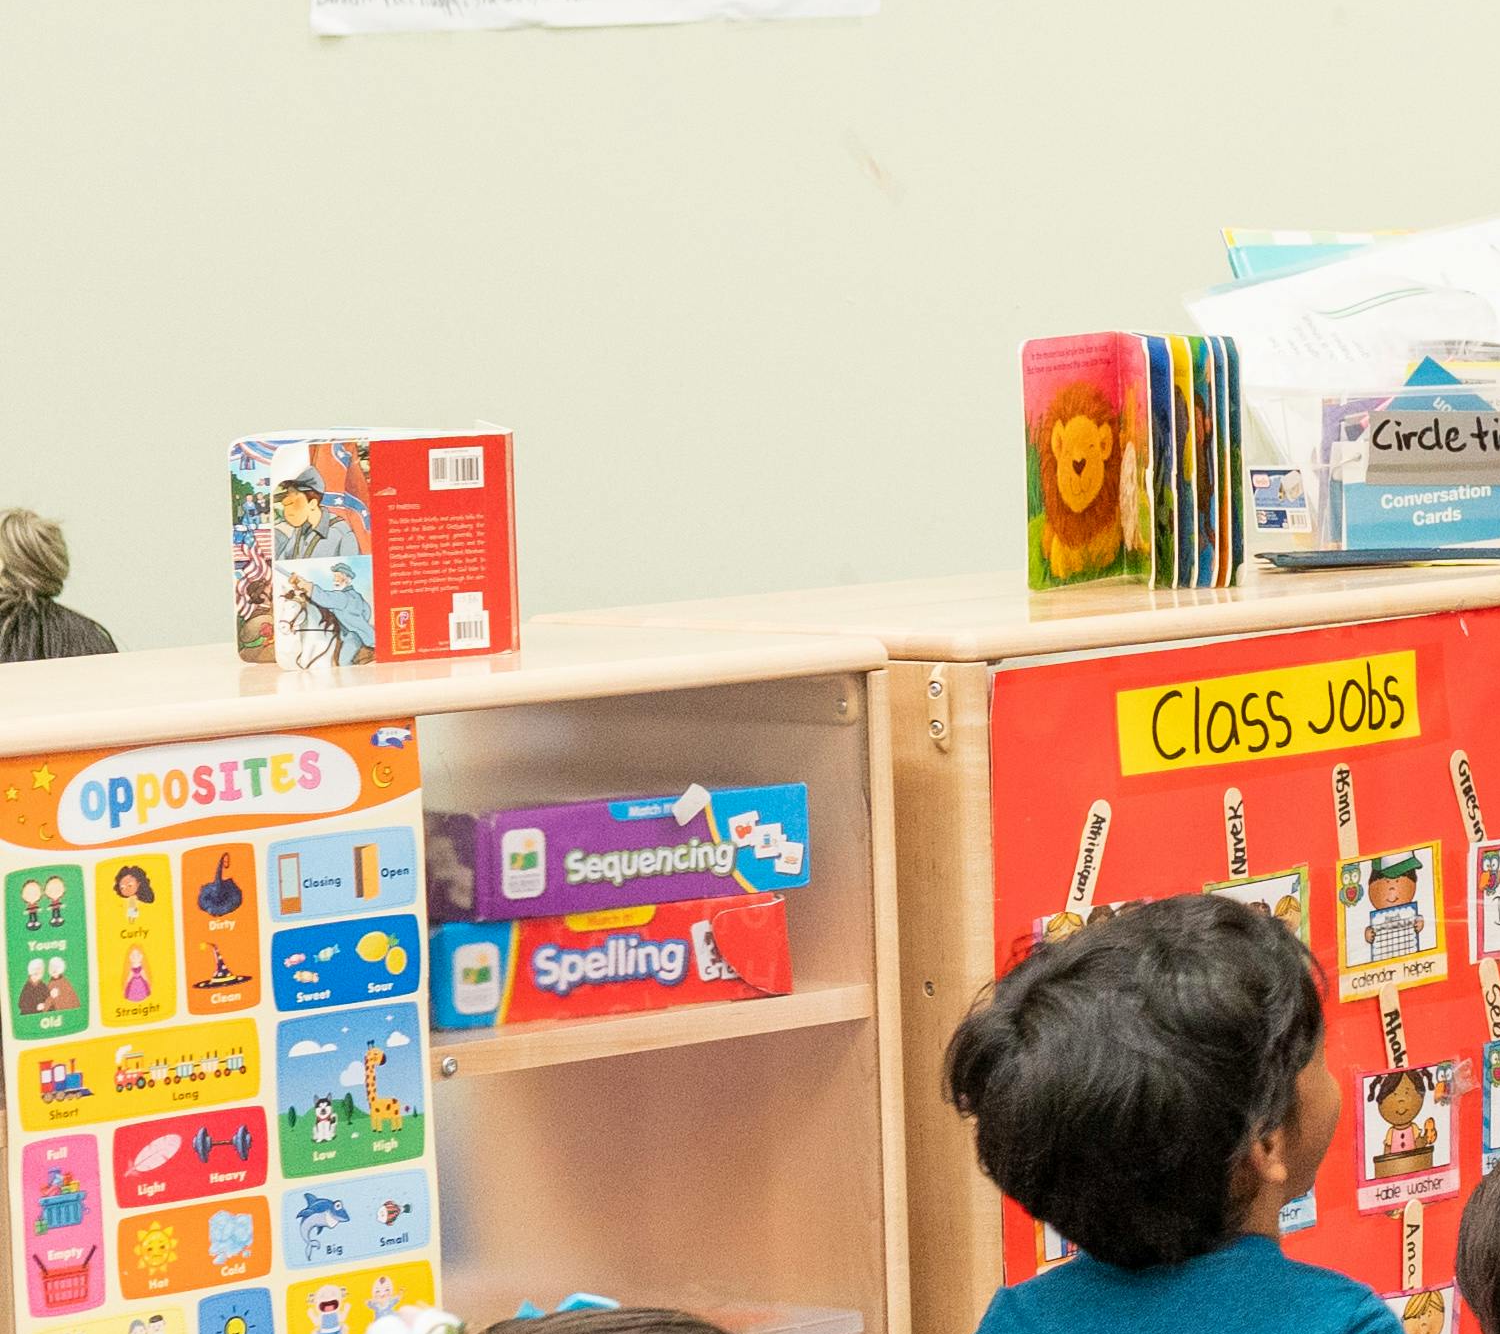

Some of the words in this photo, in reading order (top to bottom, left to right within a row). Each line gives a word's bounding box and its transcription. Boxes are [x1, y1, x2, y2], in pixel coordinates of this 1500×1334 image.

[1372, 419, 1467, 453] Circle
[1381, 484, 1492, 510] Conversation
[1412, 507, 1462, 526] Cards
[1151, 685, 1294, 761] Class
[1307, 660, 1407, 736] Jobs
[79, 750, 322, 829] OPPOSITES
[565, 838, 737, 886] Sequencing
[302, 875, 342, 890] Closing
[120, 927, 149, 940] Curly
[209, 918, 236, 932] Dirty
[533, 935, 689, 997] Spelling
[1352, 969, 1397, 989] calendar
[1403, 960, 1436, 979] helper
[211, 991, 242, 1004] Clean
[209, 1169, 246, 1185] Heavy
[1374, 1185, 1401, 1201] table
[1407, 1176, 1444, 1196] washer
